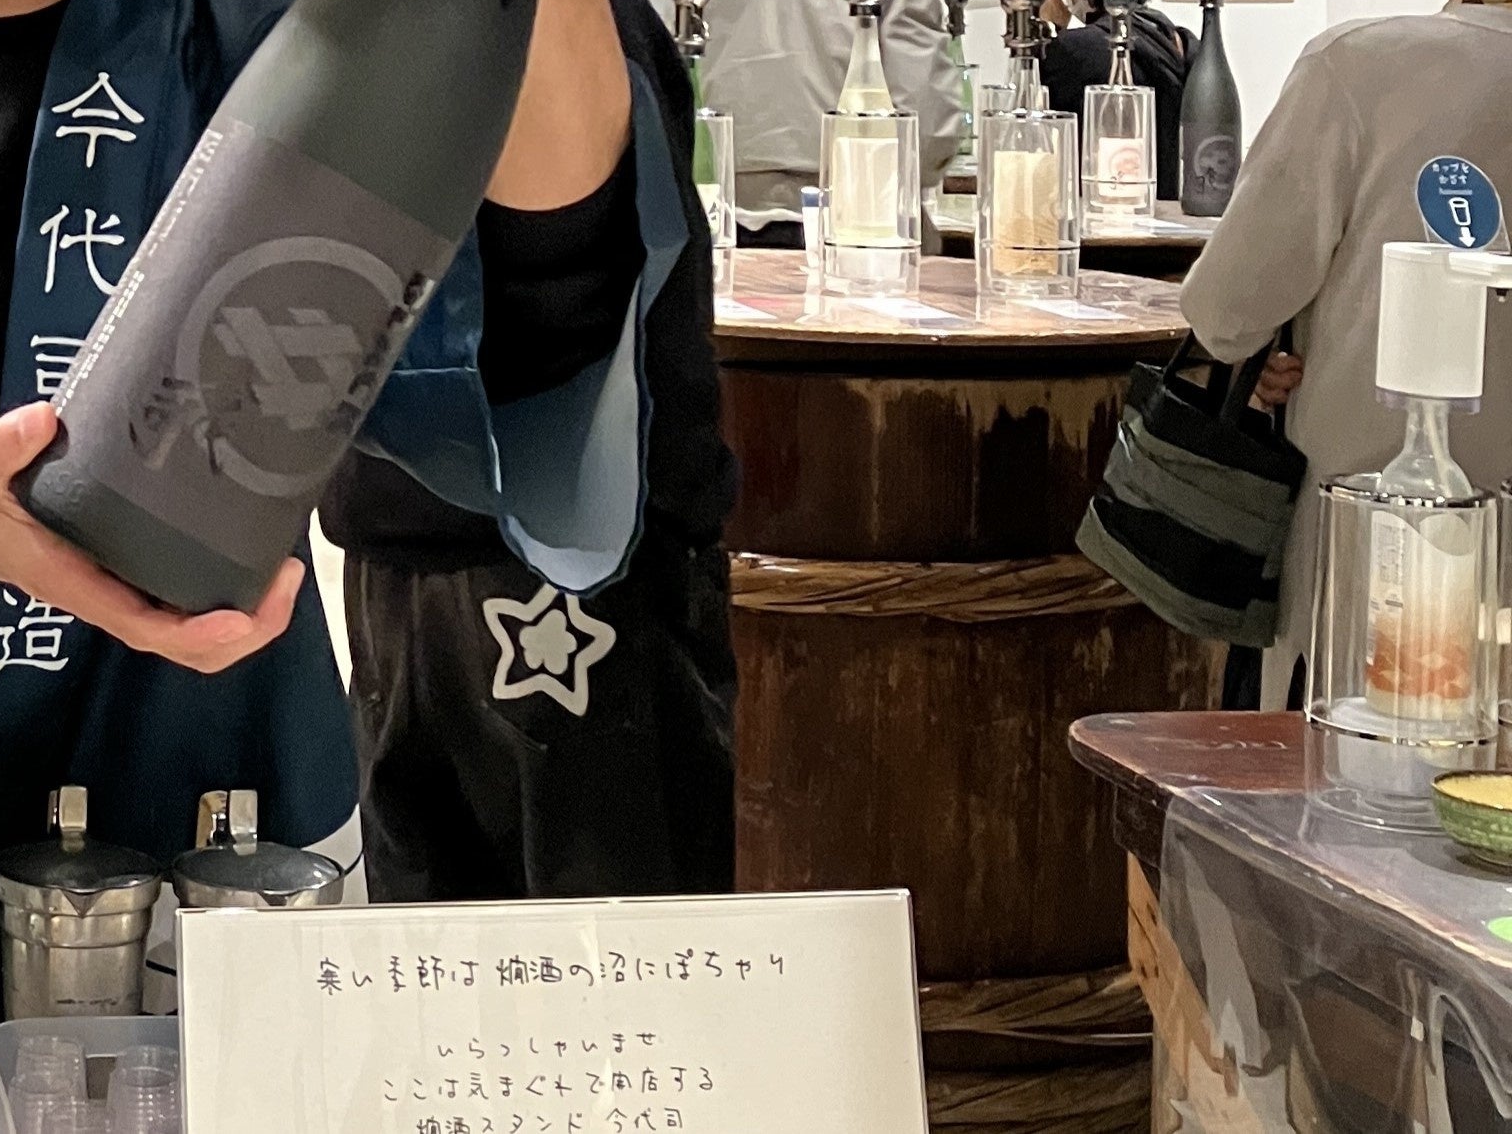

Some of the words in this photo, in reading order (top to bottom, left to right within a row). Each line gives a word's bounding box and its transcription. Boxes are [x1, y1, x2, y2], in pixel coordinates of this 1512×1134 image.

[437, 1032, 657, 1059] いらっしゃいませ
[384, 1066, 714, 1102] ここは気まぐれで開店する
